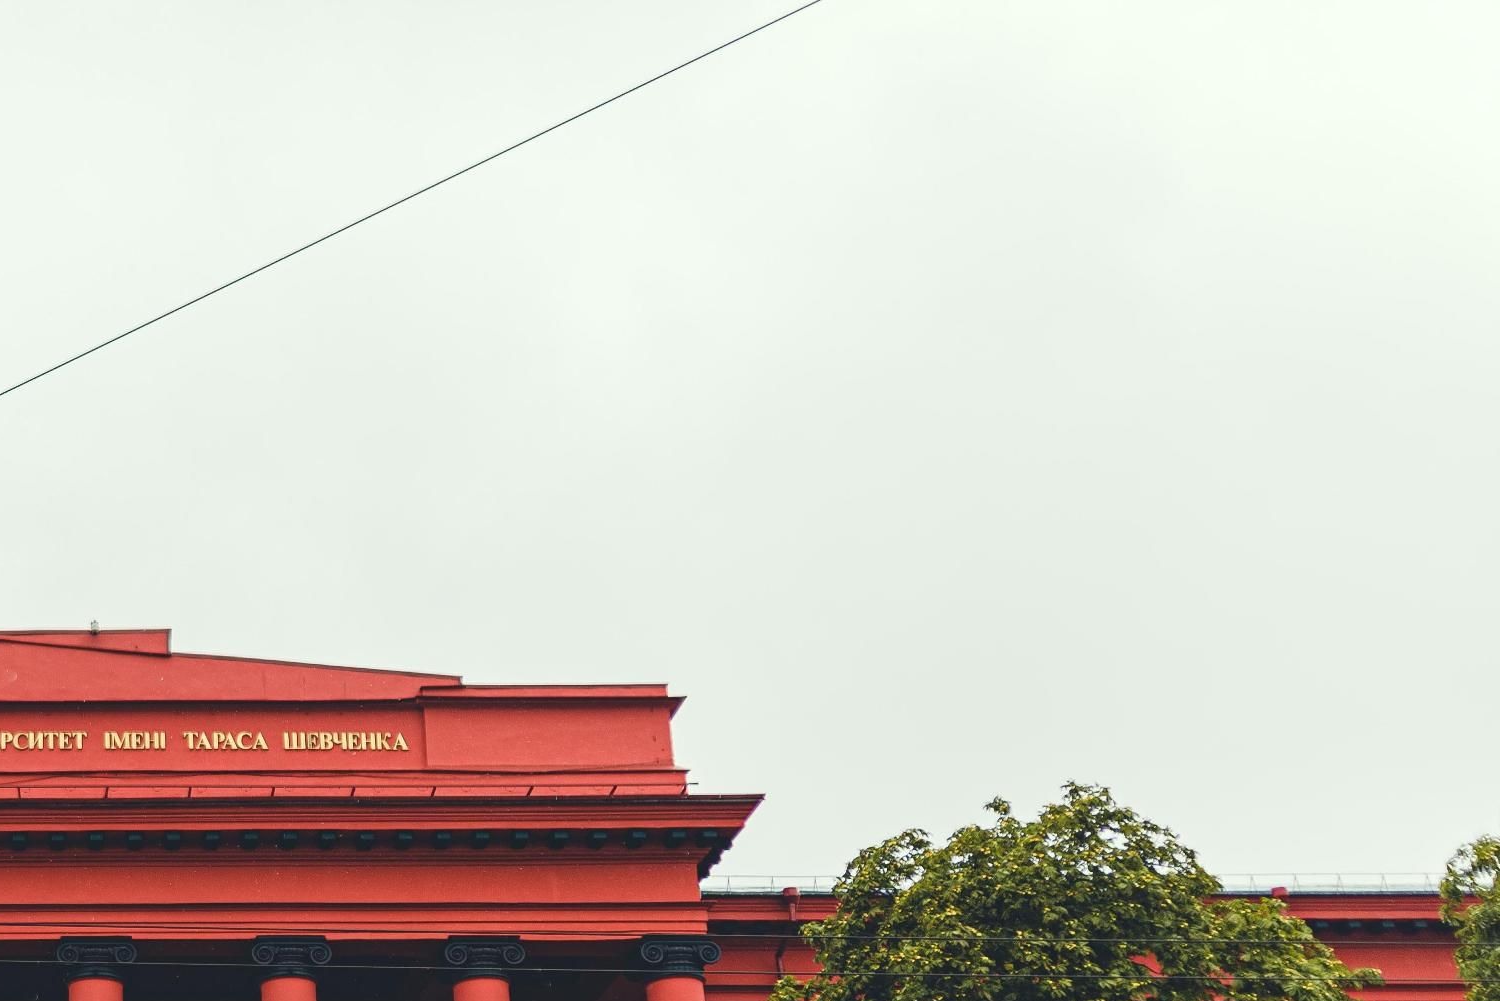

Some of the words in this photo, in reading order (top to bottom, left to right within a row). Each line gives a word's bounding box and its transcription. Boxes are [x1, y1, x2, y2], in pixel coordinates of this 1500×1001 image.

[104, 731, 166, 750] ІМЕНІ
[183, 731, 269, 750] ТАРАСА
[283, 731, 409, 751] ШЕВЧЕНКА
